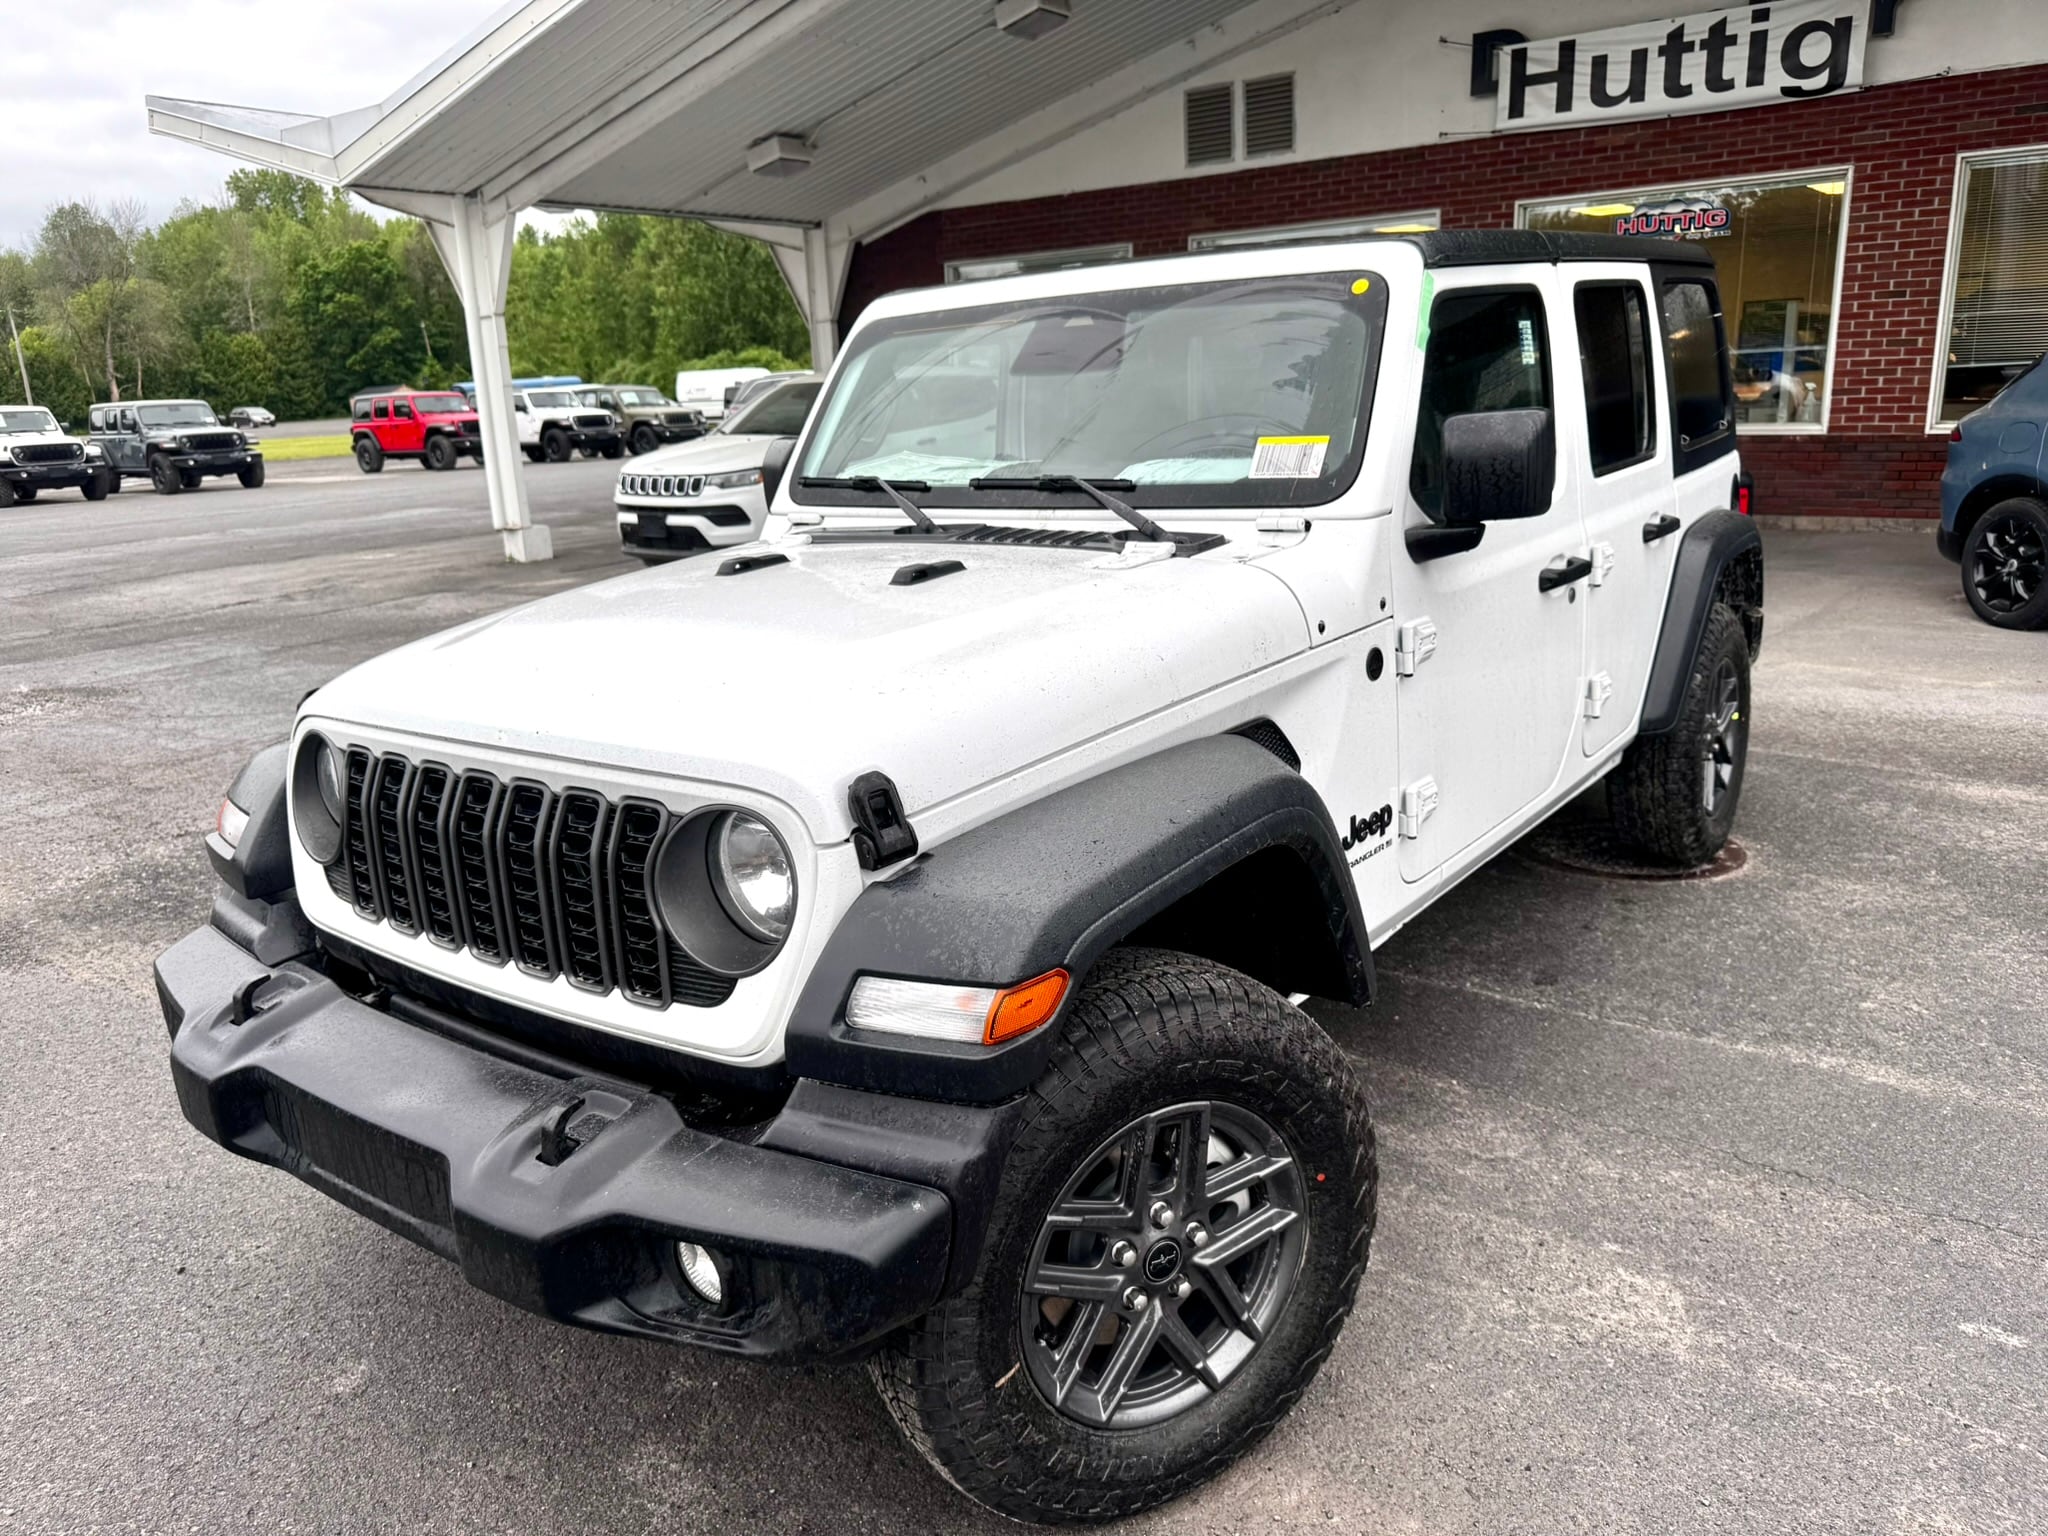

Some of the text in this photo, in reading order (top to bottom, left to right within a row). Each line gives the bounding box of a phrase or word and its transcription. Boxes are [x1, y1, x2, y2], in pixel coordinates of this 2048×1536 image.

[1508, 7, 1854, 119] Huttig
[1617, 209, 1727, 236] HUTTIG
[1342, 804, 1392, 850] Jeep
[1349, 843, 1384, 868] RANGLER
